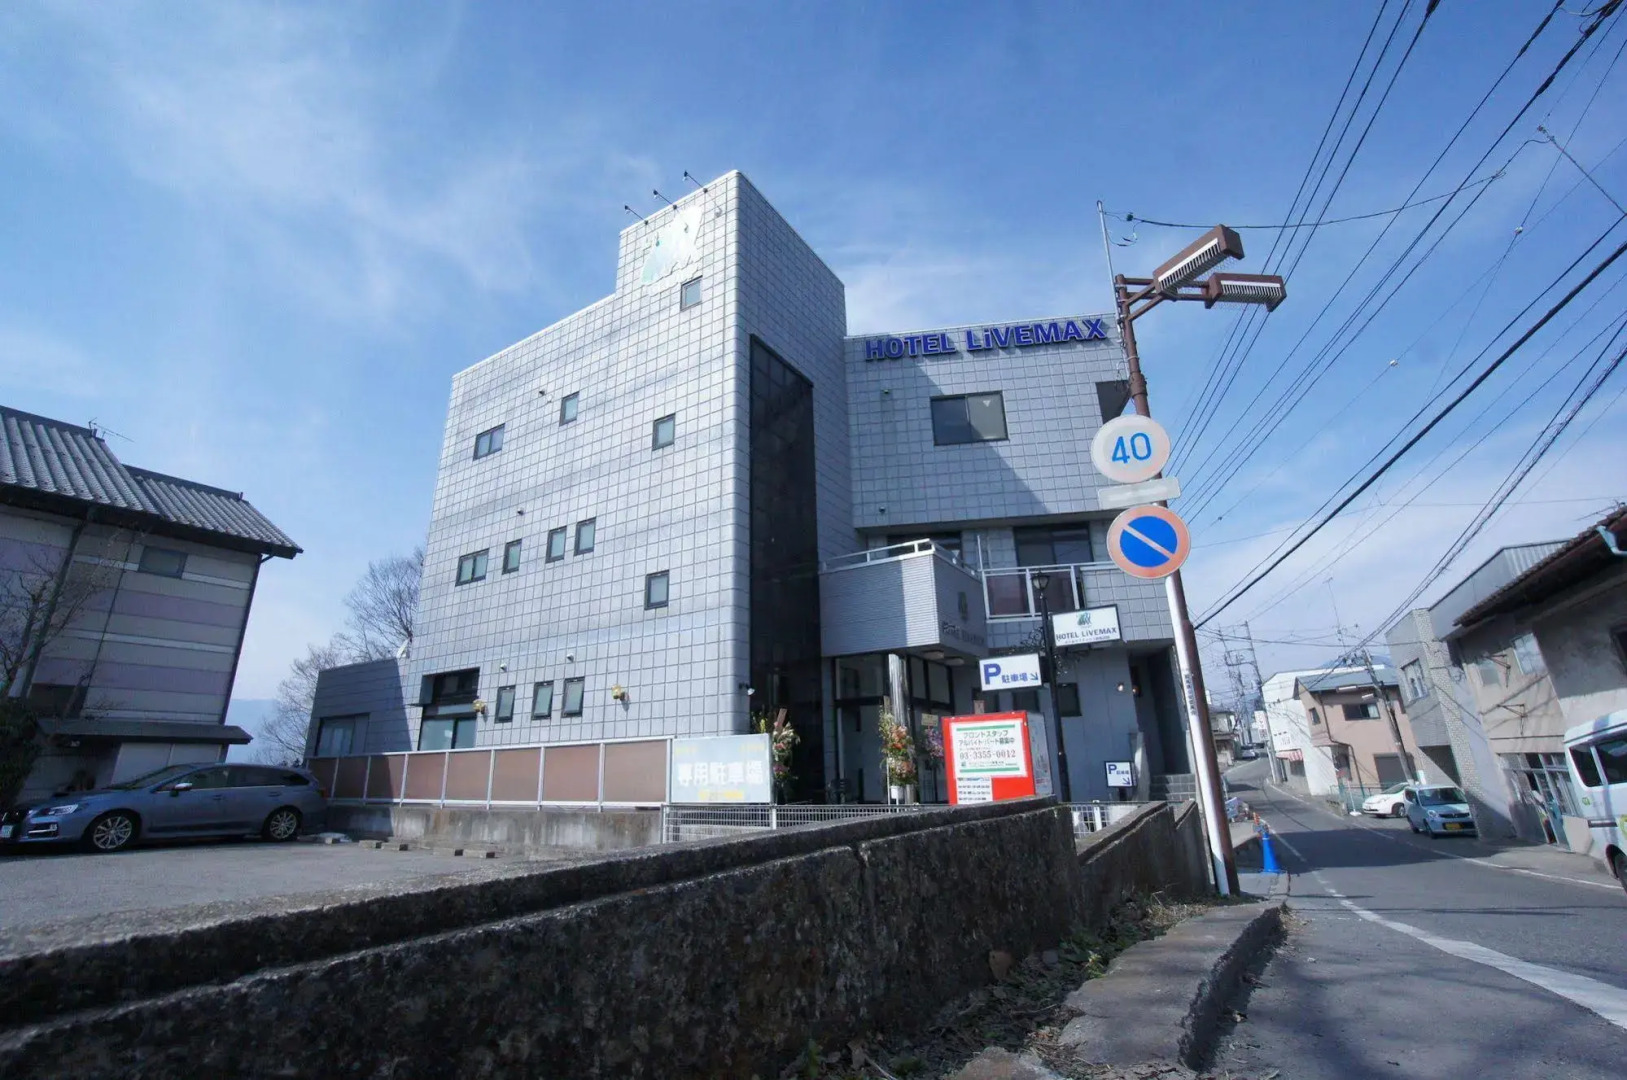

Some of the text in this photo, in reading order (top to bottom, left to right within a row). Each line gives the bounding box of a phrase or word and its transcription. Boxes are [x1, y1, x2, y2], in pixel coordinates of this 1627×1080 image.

[865, 318, 1107, 360] HOTEL LiVEMAX
[1111, 432, 1152, 464] 40
[1056, 631, 1079, 641] HOTEL
[983, 663, 1028, 685] P 駐車場
[677, 759, 763, 786] 専用駐車場
[1108, 764, 1117, 774] P
